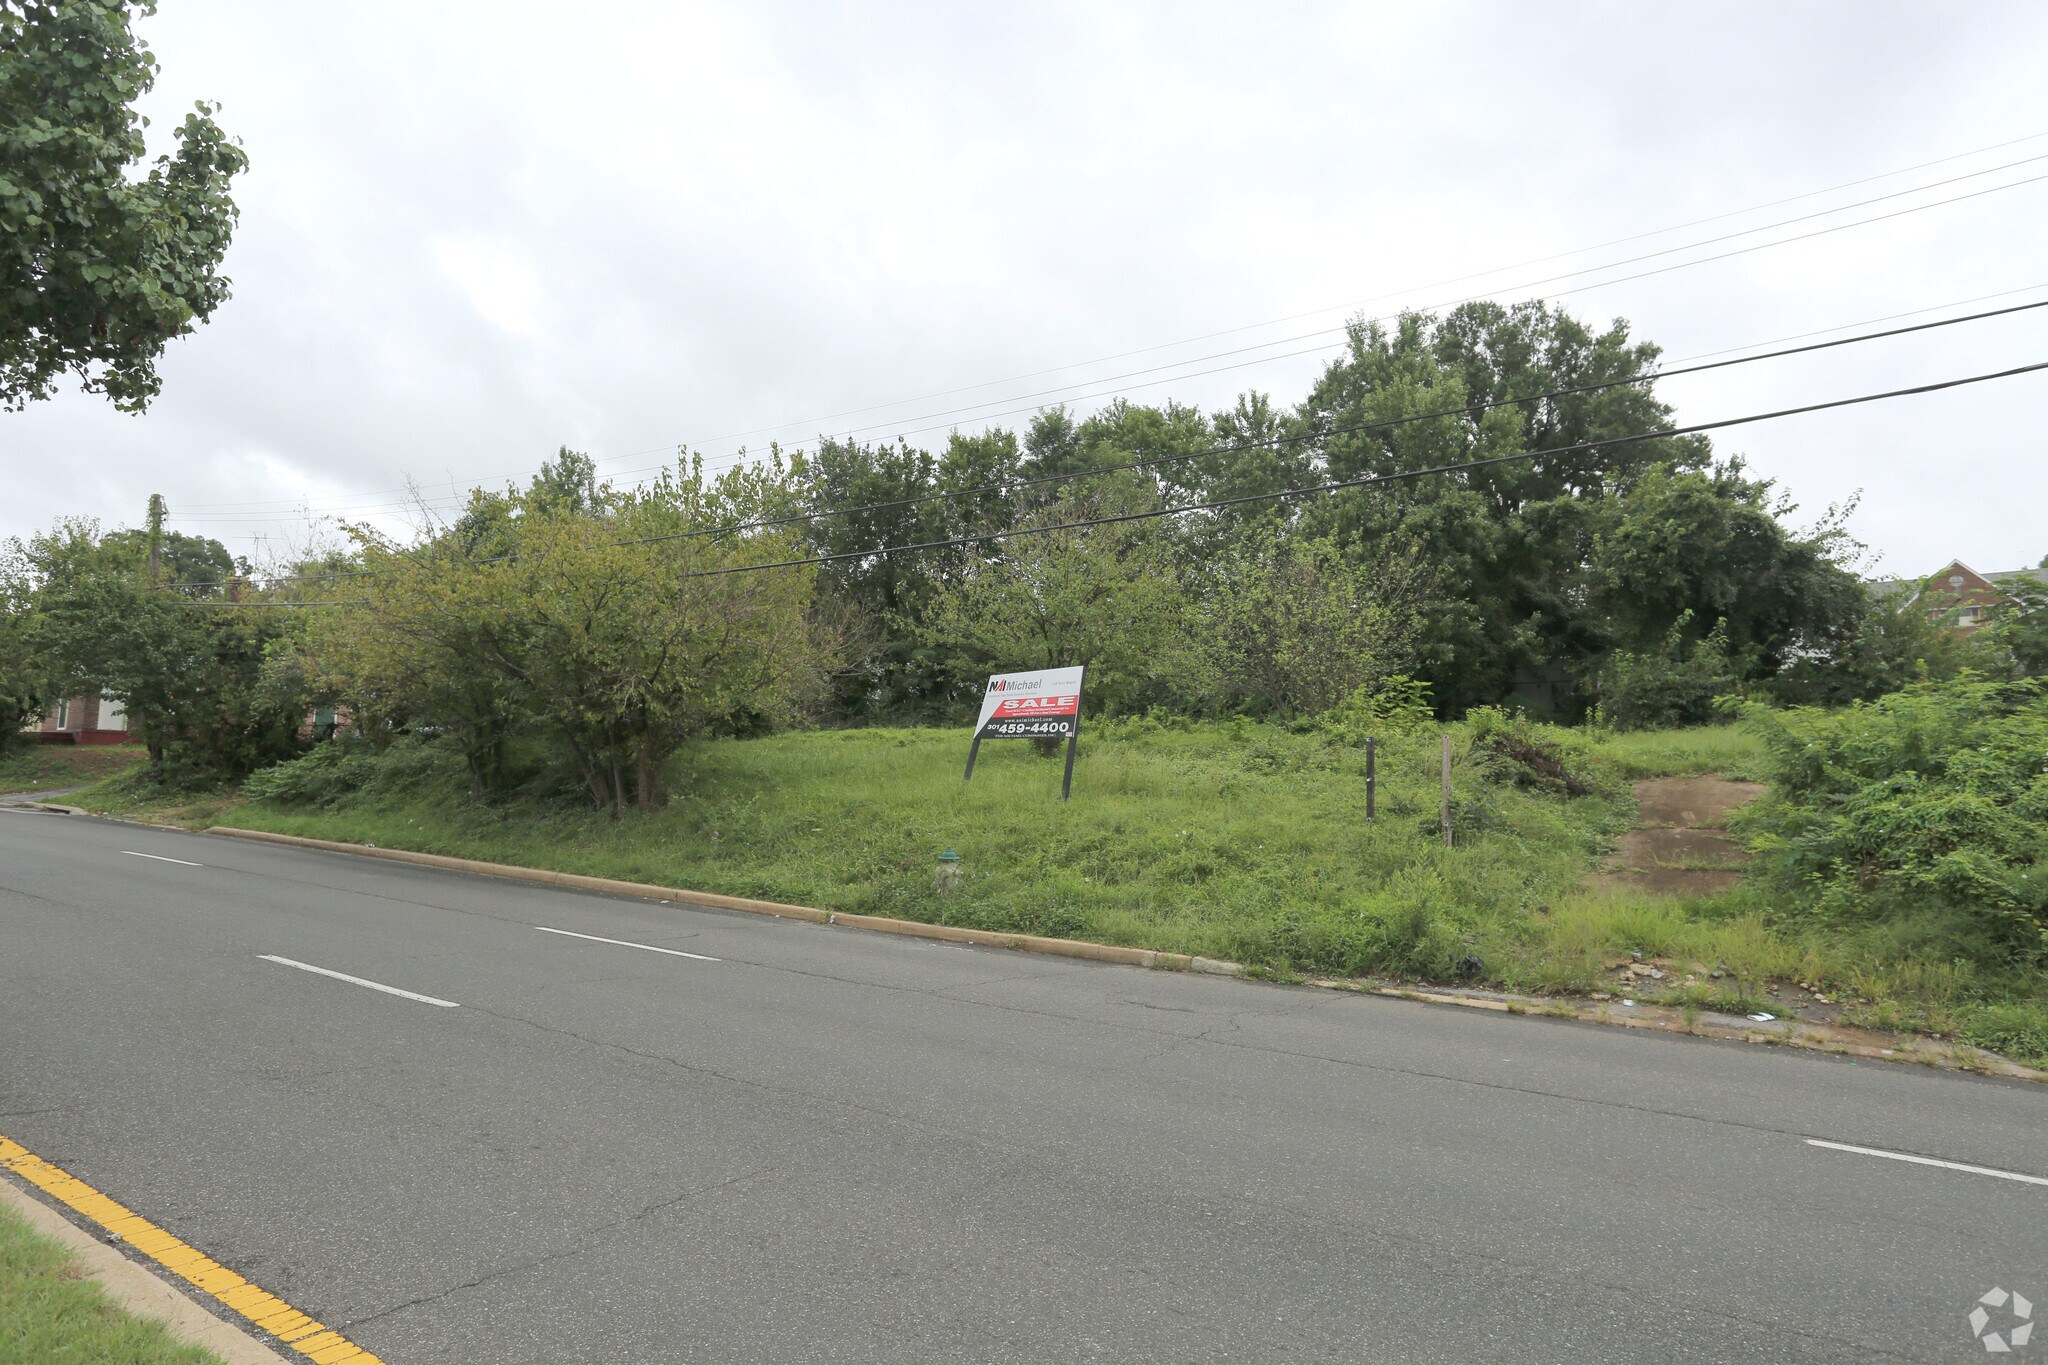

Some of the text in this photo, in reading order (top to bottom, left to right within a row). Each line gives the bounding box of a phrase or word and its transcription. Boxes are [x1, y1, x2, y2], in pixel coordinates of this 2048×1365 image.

[989, 679, 1006, 692] NAI
[1006, 679, 1042, 691] Michael
[1003, 696, 1075, 709] SALE
[998, 722, 1069, 734] 459-4400
